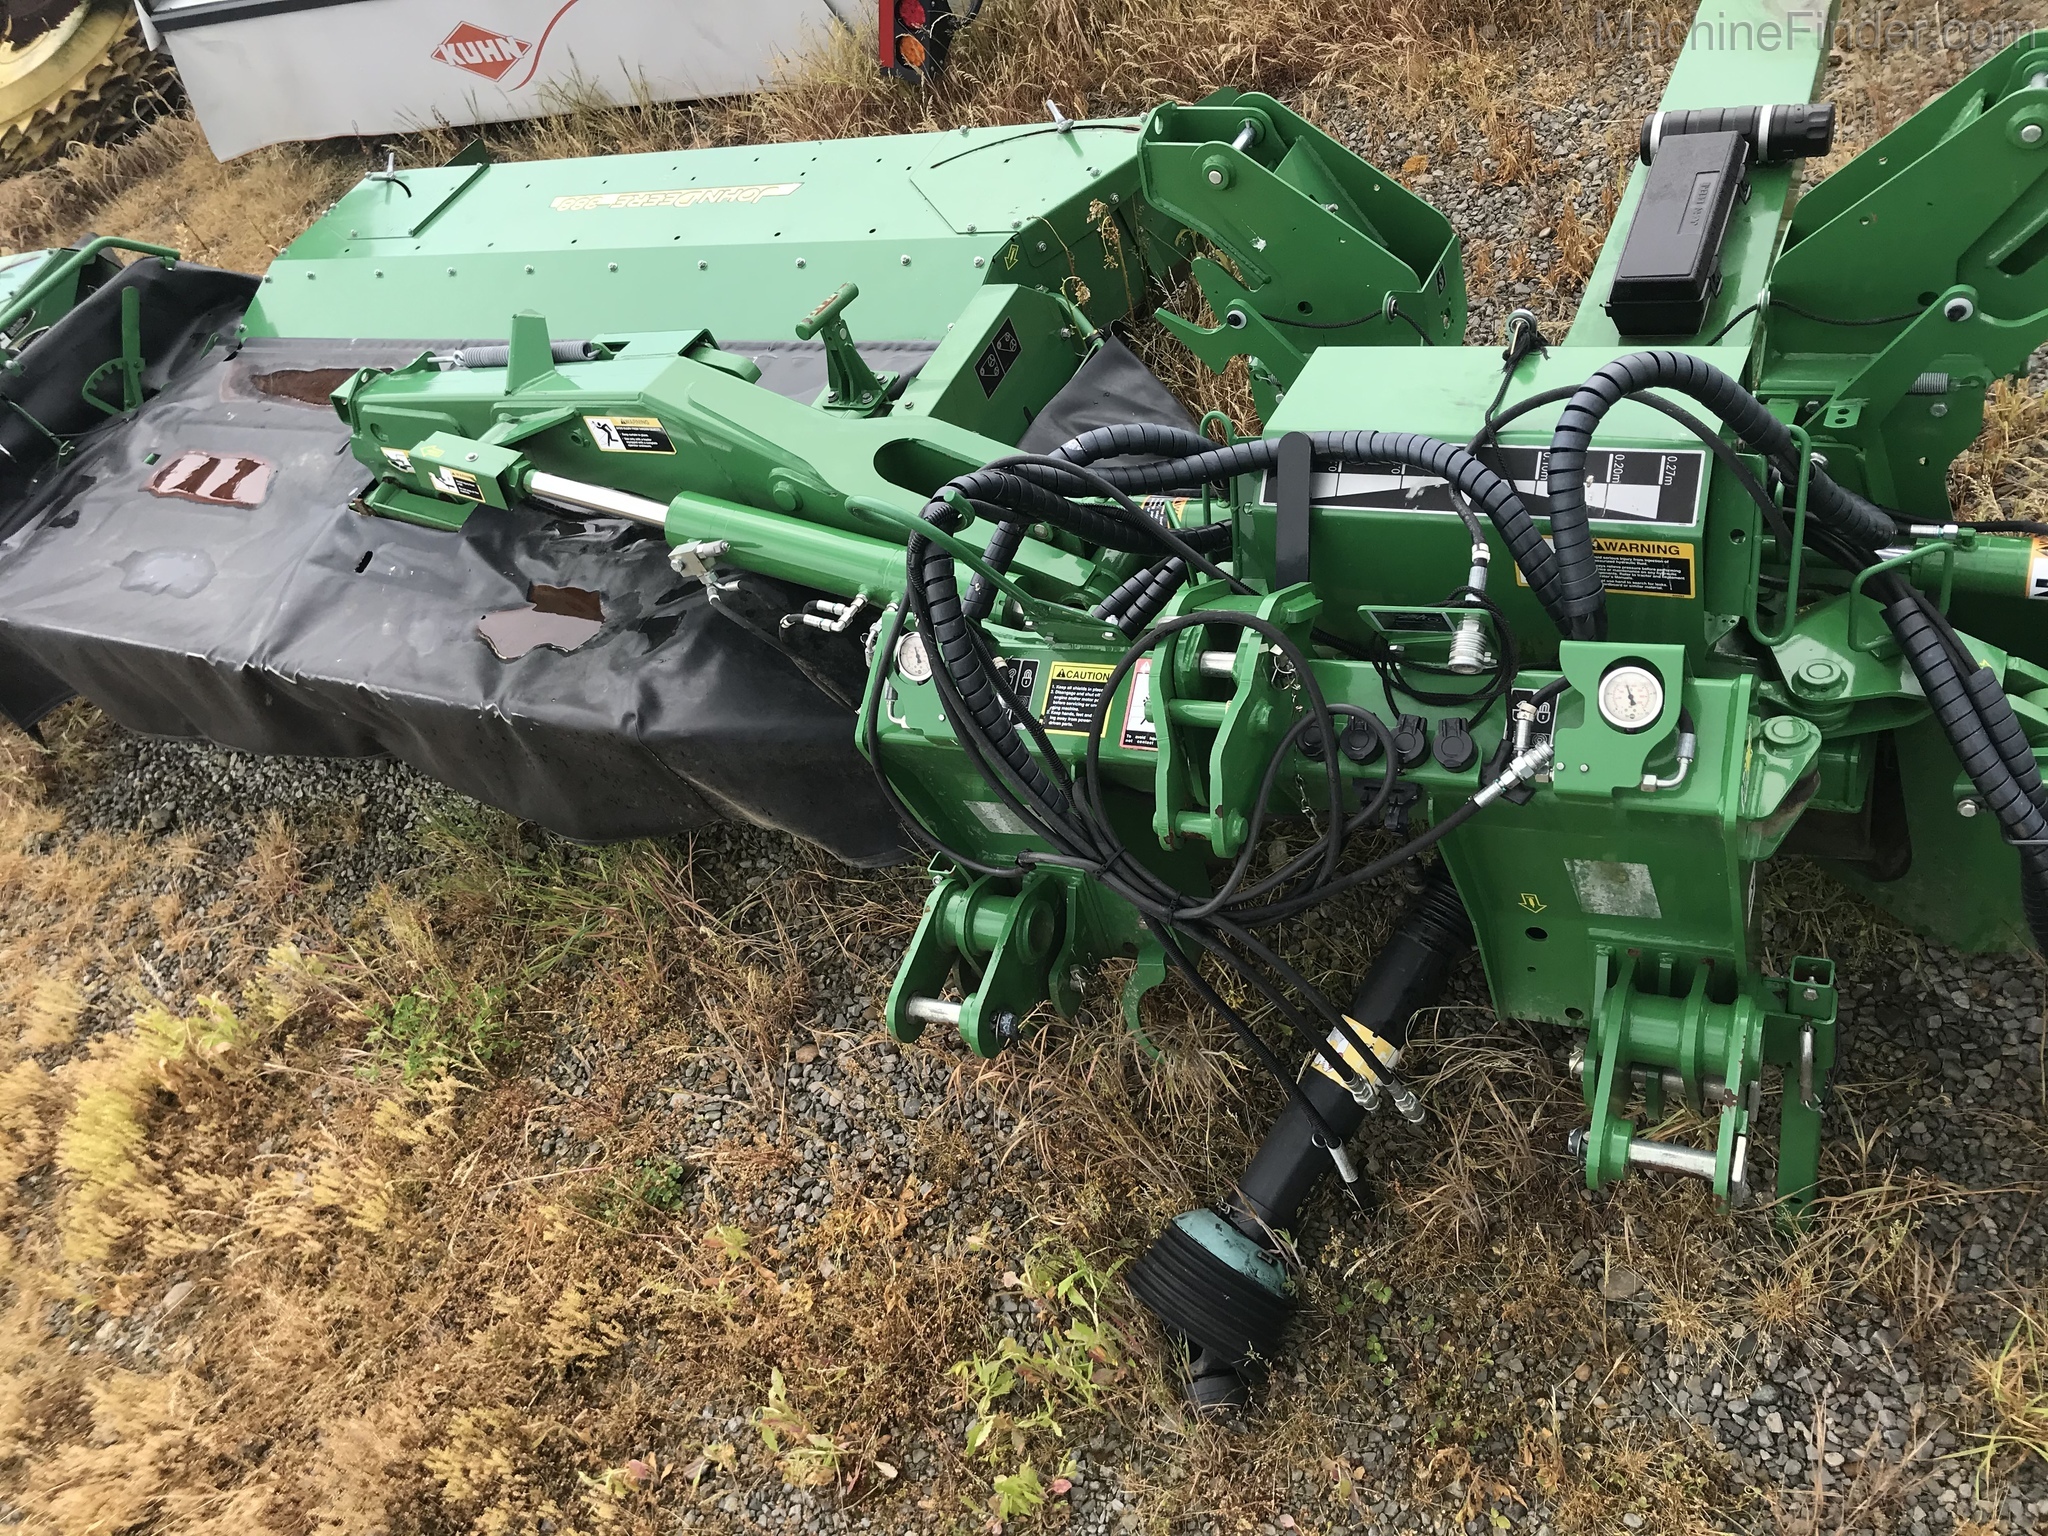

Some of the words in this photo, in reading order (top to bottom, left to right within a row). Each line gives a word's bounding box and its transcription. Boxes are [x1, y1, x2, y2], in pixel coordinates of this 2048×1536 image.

[438, 35, 524, 67] KUHN
[609, 189, 702, 209] DEERE
[696, 186, 780, 204] JOHN
[1611, 454, 1625, 484] 0.20m
[1664, 455, 1678, 486] 0.27m
[1604, 541, 1680, 555] WARNING
[1066, 670, 1110, 681] CAUTION
